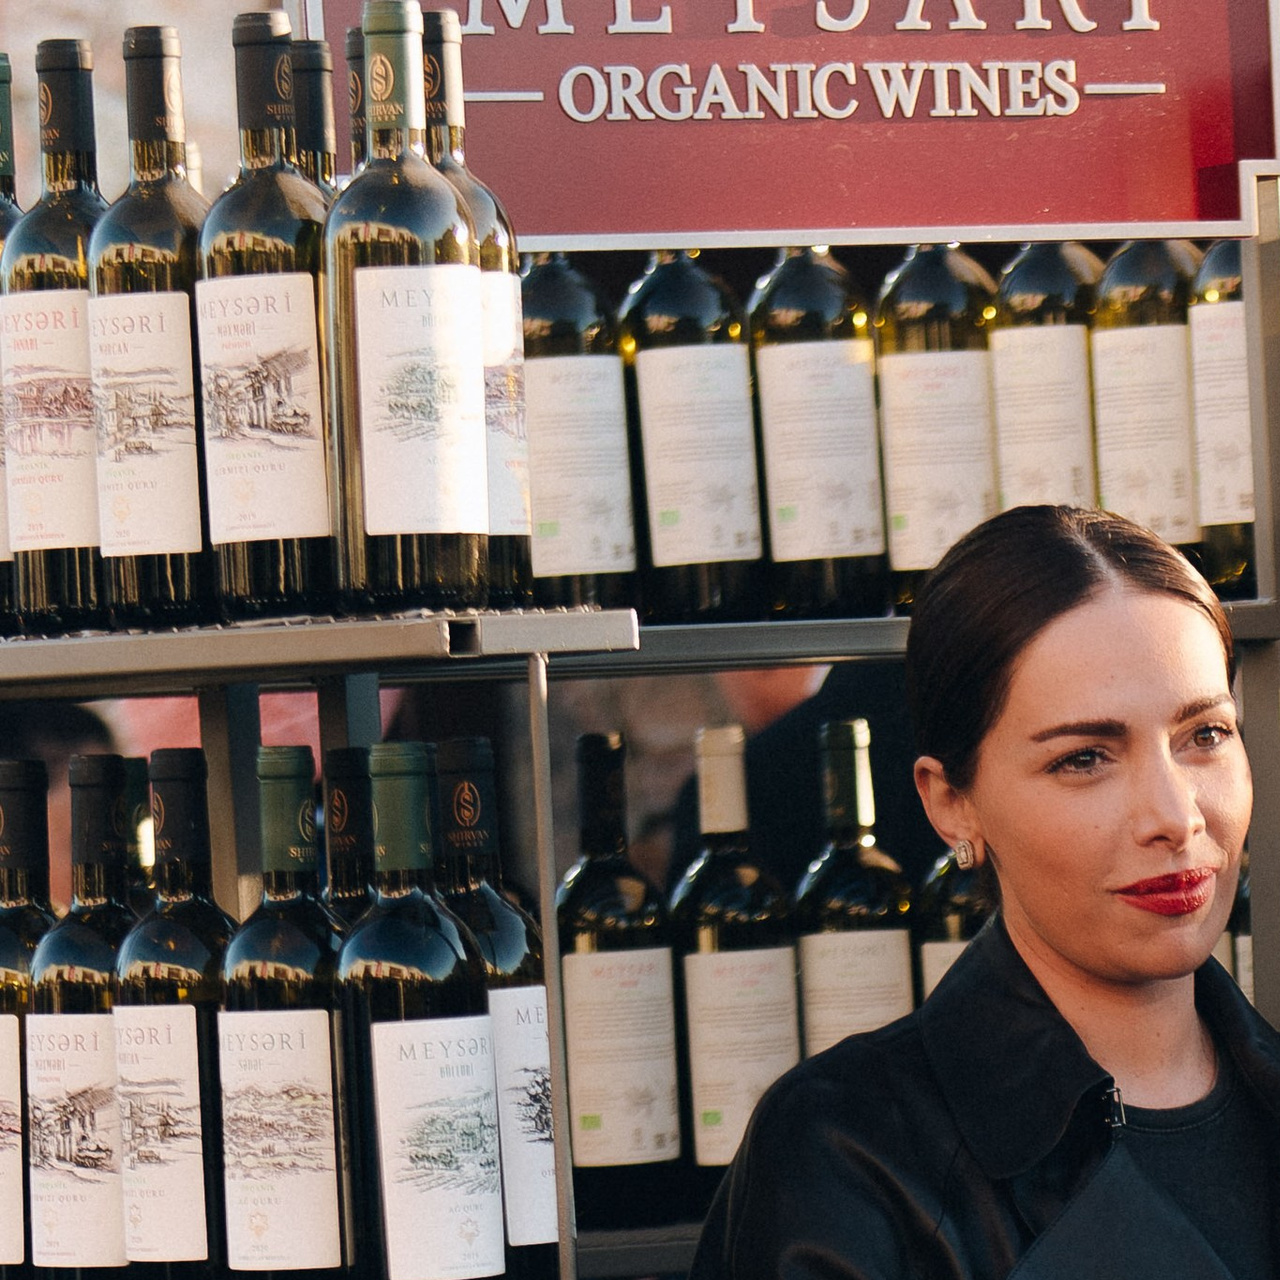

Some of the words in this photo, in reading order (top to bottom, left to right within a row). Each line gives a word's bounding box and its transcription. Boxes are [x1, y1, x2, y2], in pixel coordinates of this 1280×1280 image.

[559, 62, 859, 122] ORGANIC
[863, 60, 1080, 118] WINES
[3, 307, 80, 334] EYSƏRİ
[91, 312, 166, 337] EYSƏRİ
[252, 462, 287, 474] QURU
[30, 1031, 99, 1052] EYSƏRİ
[118, 1024, 173, 1047] YSƏRİ
